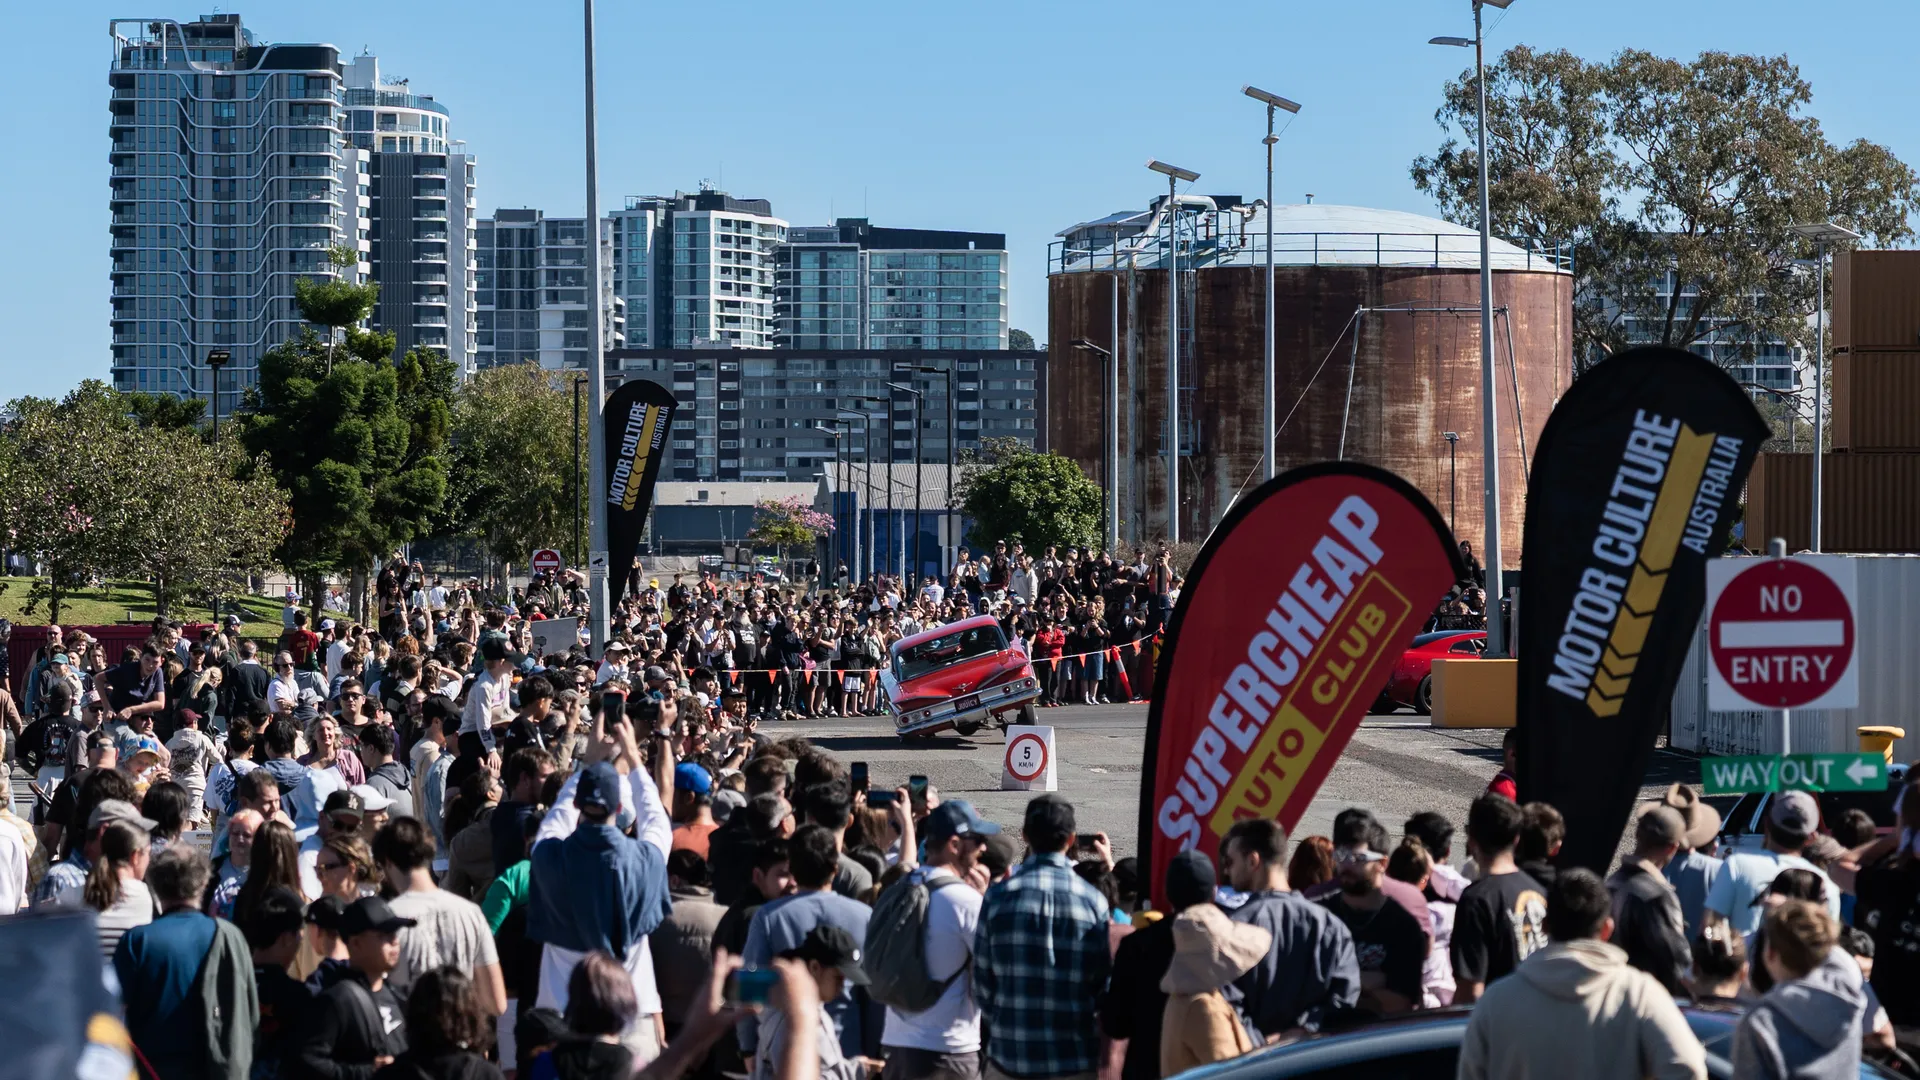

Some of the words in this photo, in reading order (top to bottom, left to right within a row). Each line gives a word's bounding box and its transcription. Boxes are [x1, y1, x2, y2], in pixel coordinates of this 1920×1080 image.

[607, 459, 633, 505] MOTOR
[621, 401, 648, 457] CULTURE
[651, 406, 669, 449] AUSTRALIA
[1682, 436, 1743, 554] AUSTRALIA
[1547, 566, 1627, 700] MOTOR
[1592, 408, 1681, 569] CULTURE
[1760, 585, 1802, 613] NO
[1158, 494, 1384, 852] SUPERCHEAP
[1312, 603, 1387, 705] CLUB
[1731, 655, 1833, 684] ENTRY
[1023, 746, 1031, 759] 5
[1712, 761, 1774, 788] WAY
[1780, 759, 1835, 785] OUT
